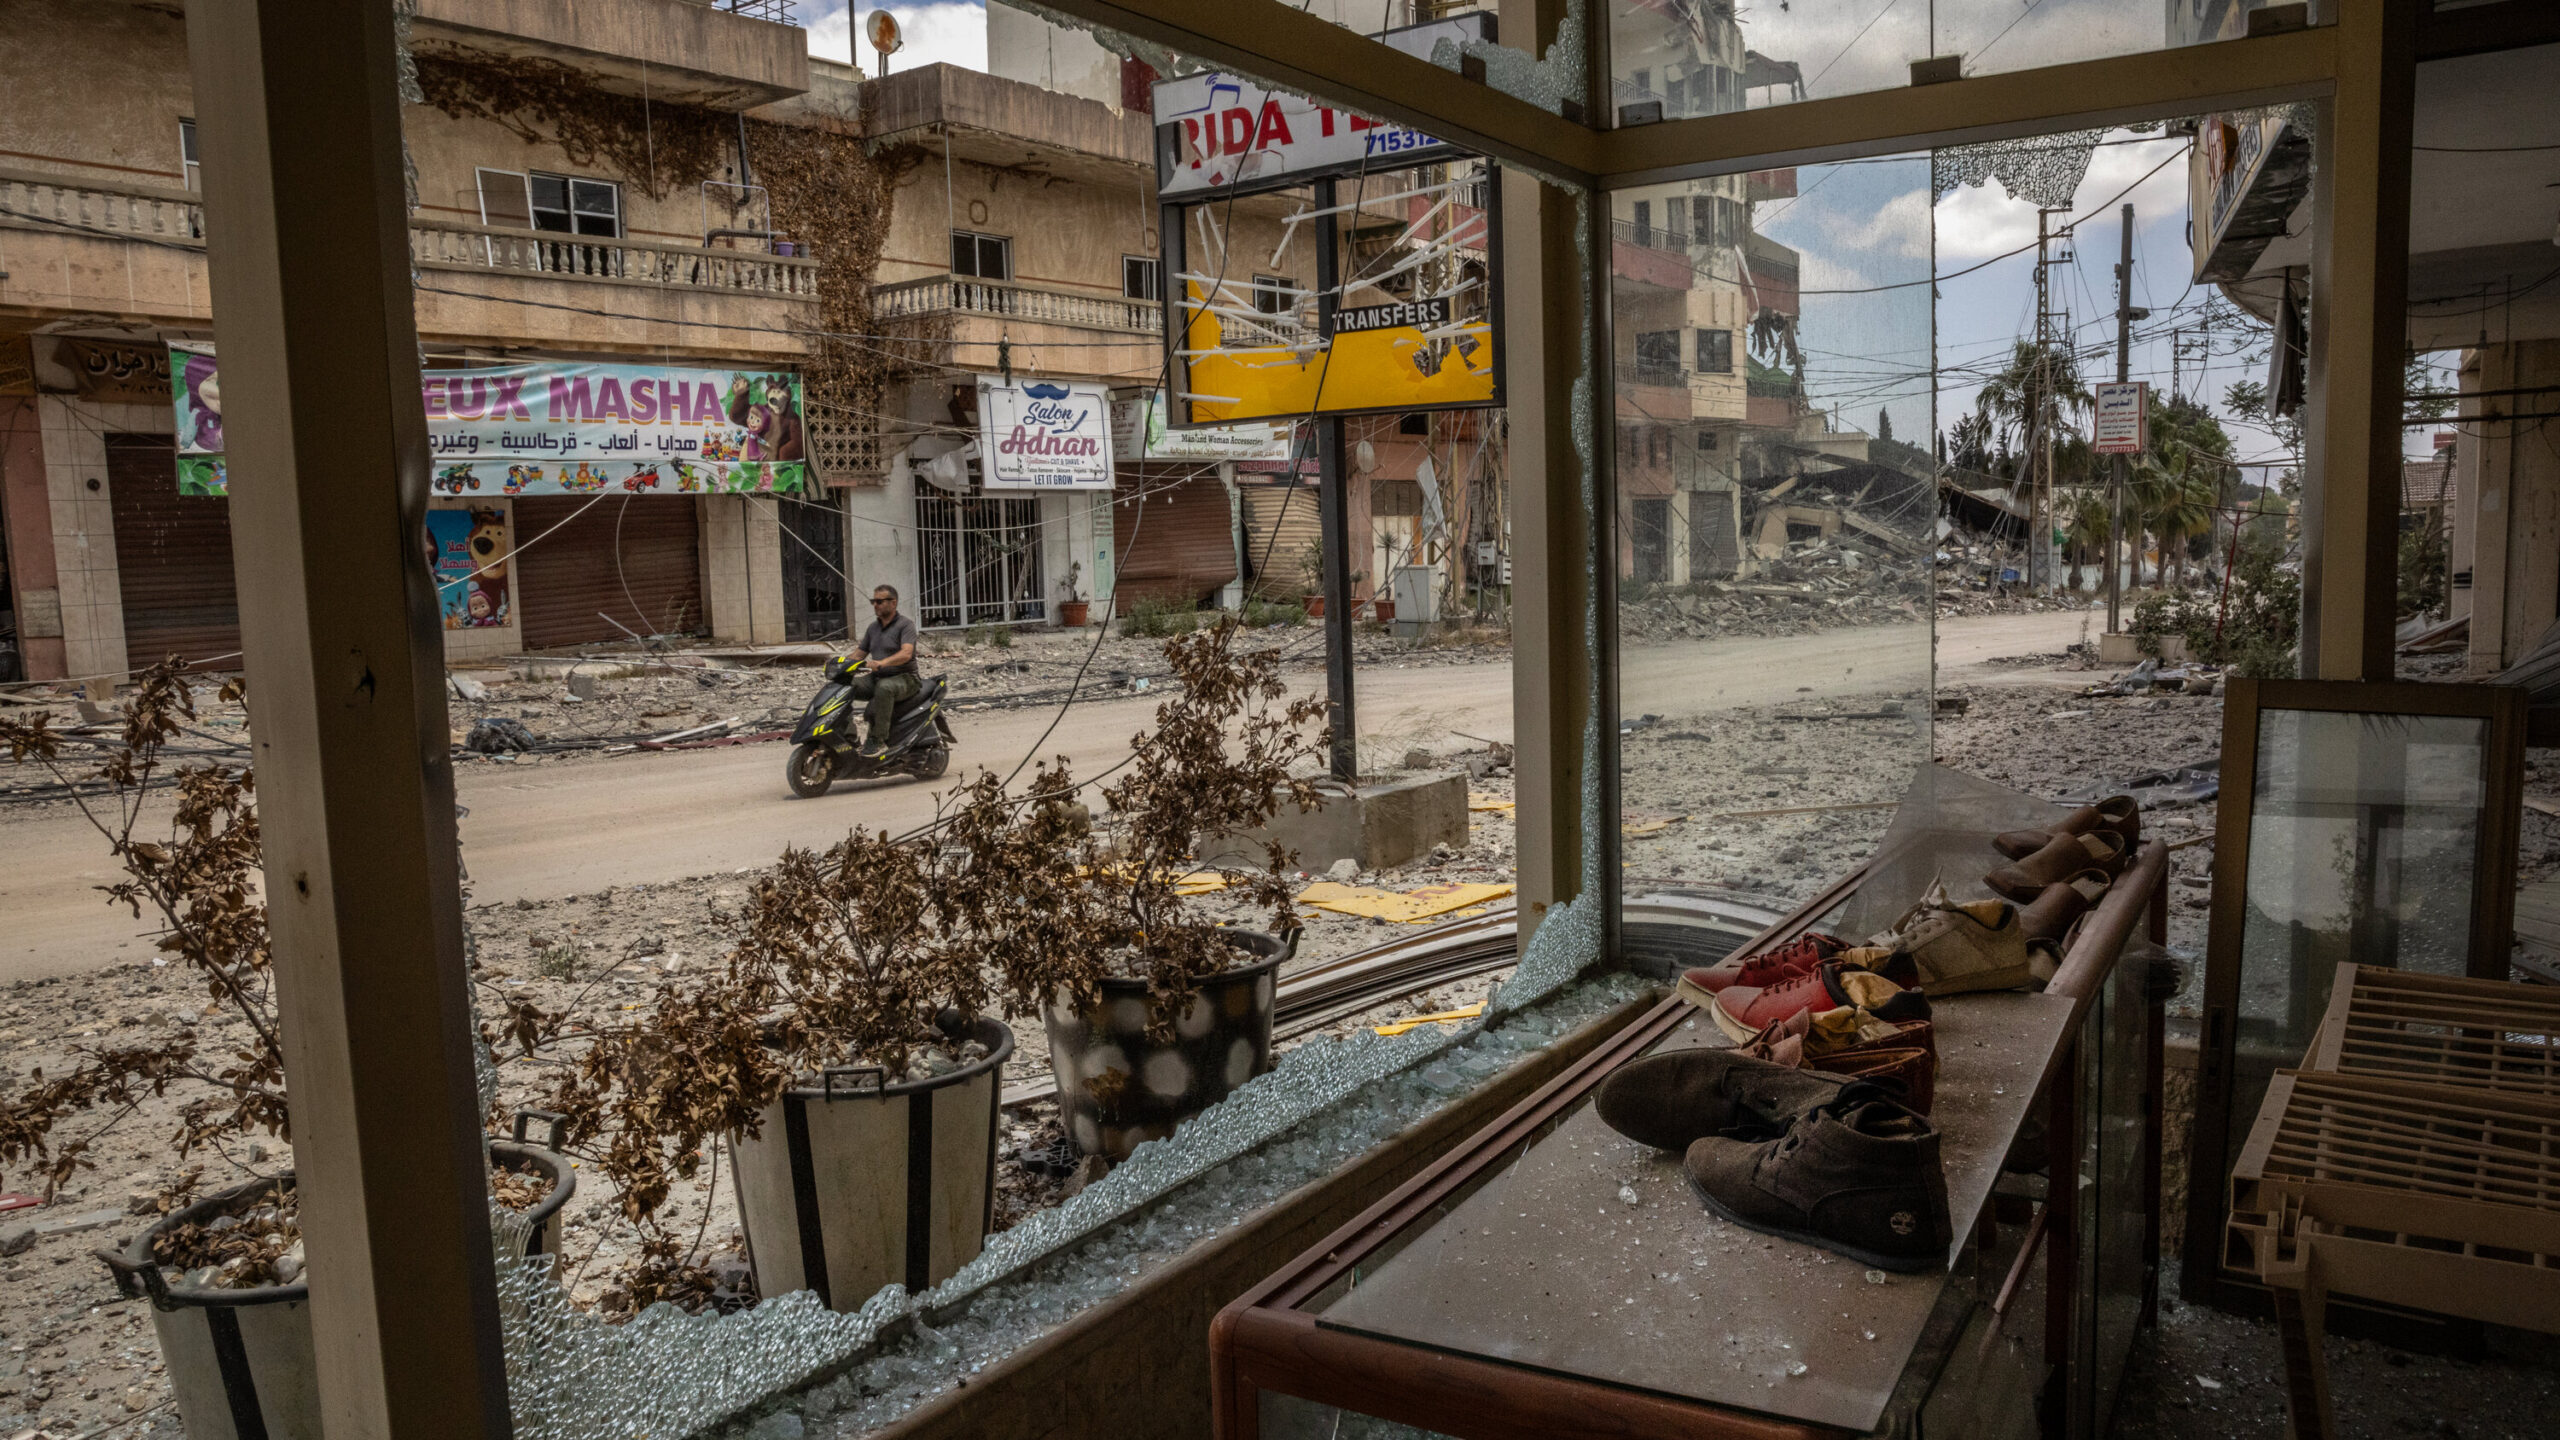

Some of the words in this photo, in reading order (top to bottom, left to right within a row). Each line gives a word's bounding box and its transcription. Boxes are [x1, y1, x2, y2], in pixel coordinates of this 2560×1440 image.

[1331, 301, 1441, 332] TRANSFERS
[423, 376, 531, 422] EUX
[548, 375, 726, 427] MASHA
[1023, 401, 1073, 425] Salon
[501, 431, 577, 455] قرطاسية
[598, 428, 639, 455] ألعاب
[657, 434, 698, 456] هدايا
[1000, 425, 1099, 456] Adnan
[1208, 435, 1230, 444] Woman
[1231, 436, 1264, 446] Accessories
[1035, 475, 1044, 485] LET
[1046, 475, 1052, 485] IT
[1054, 475, 1073, 486] GROW
